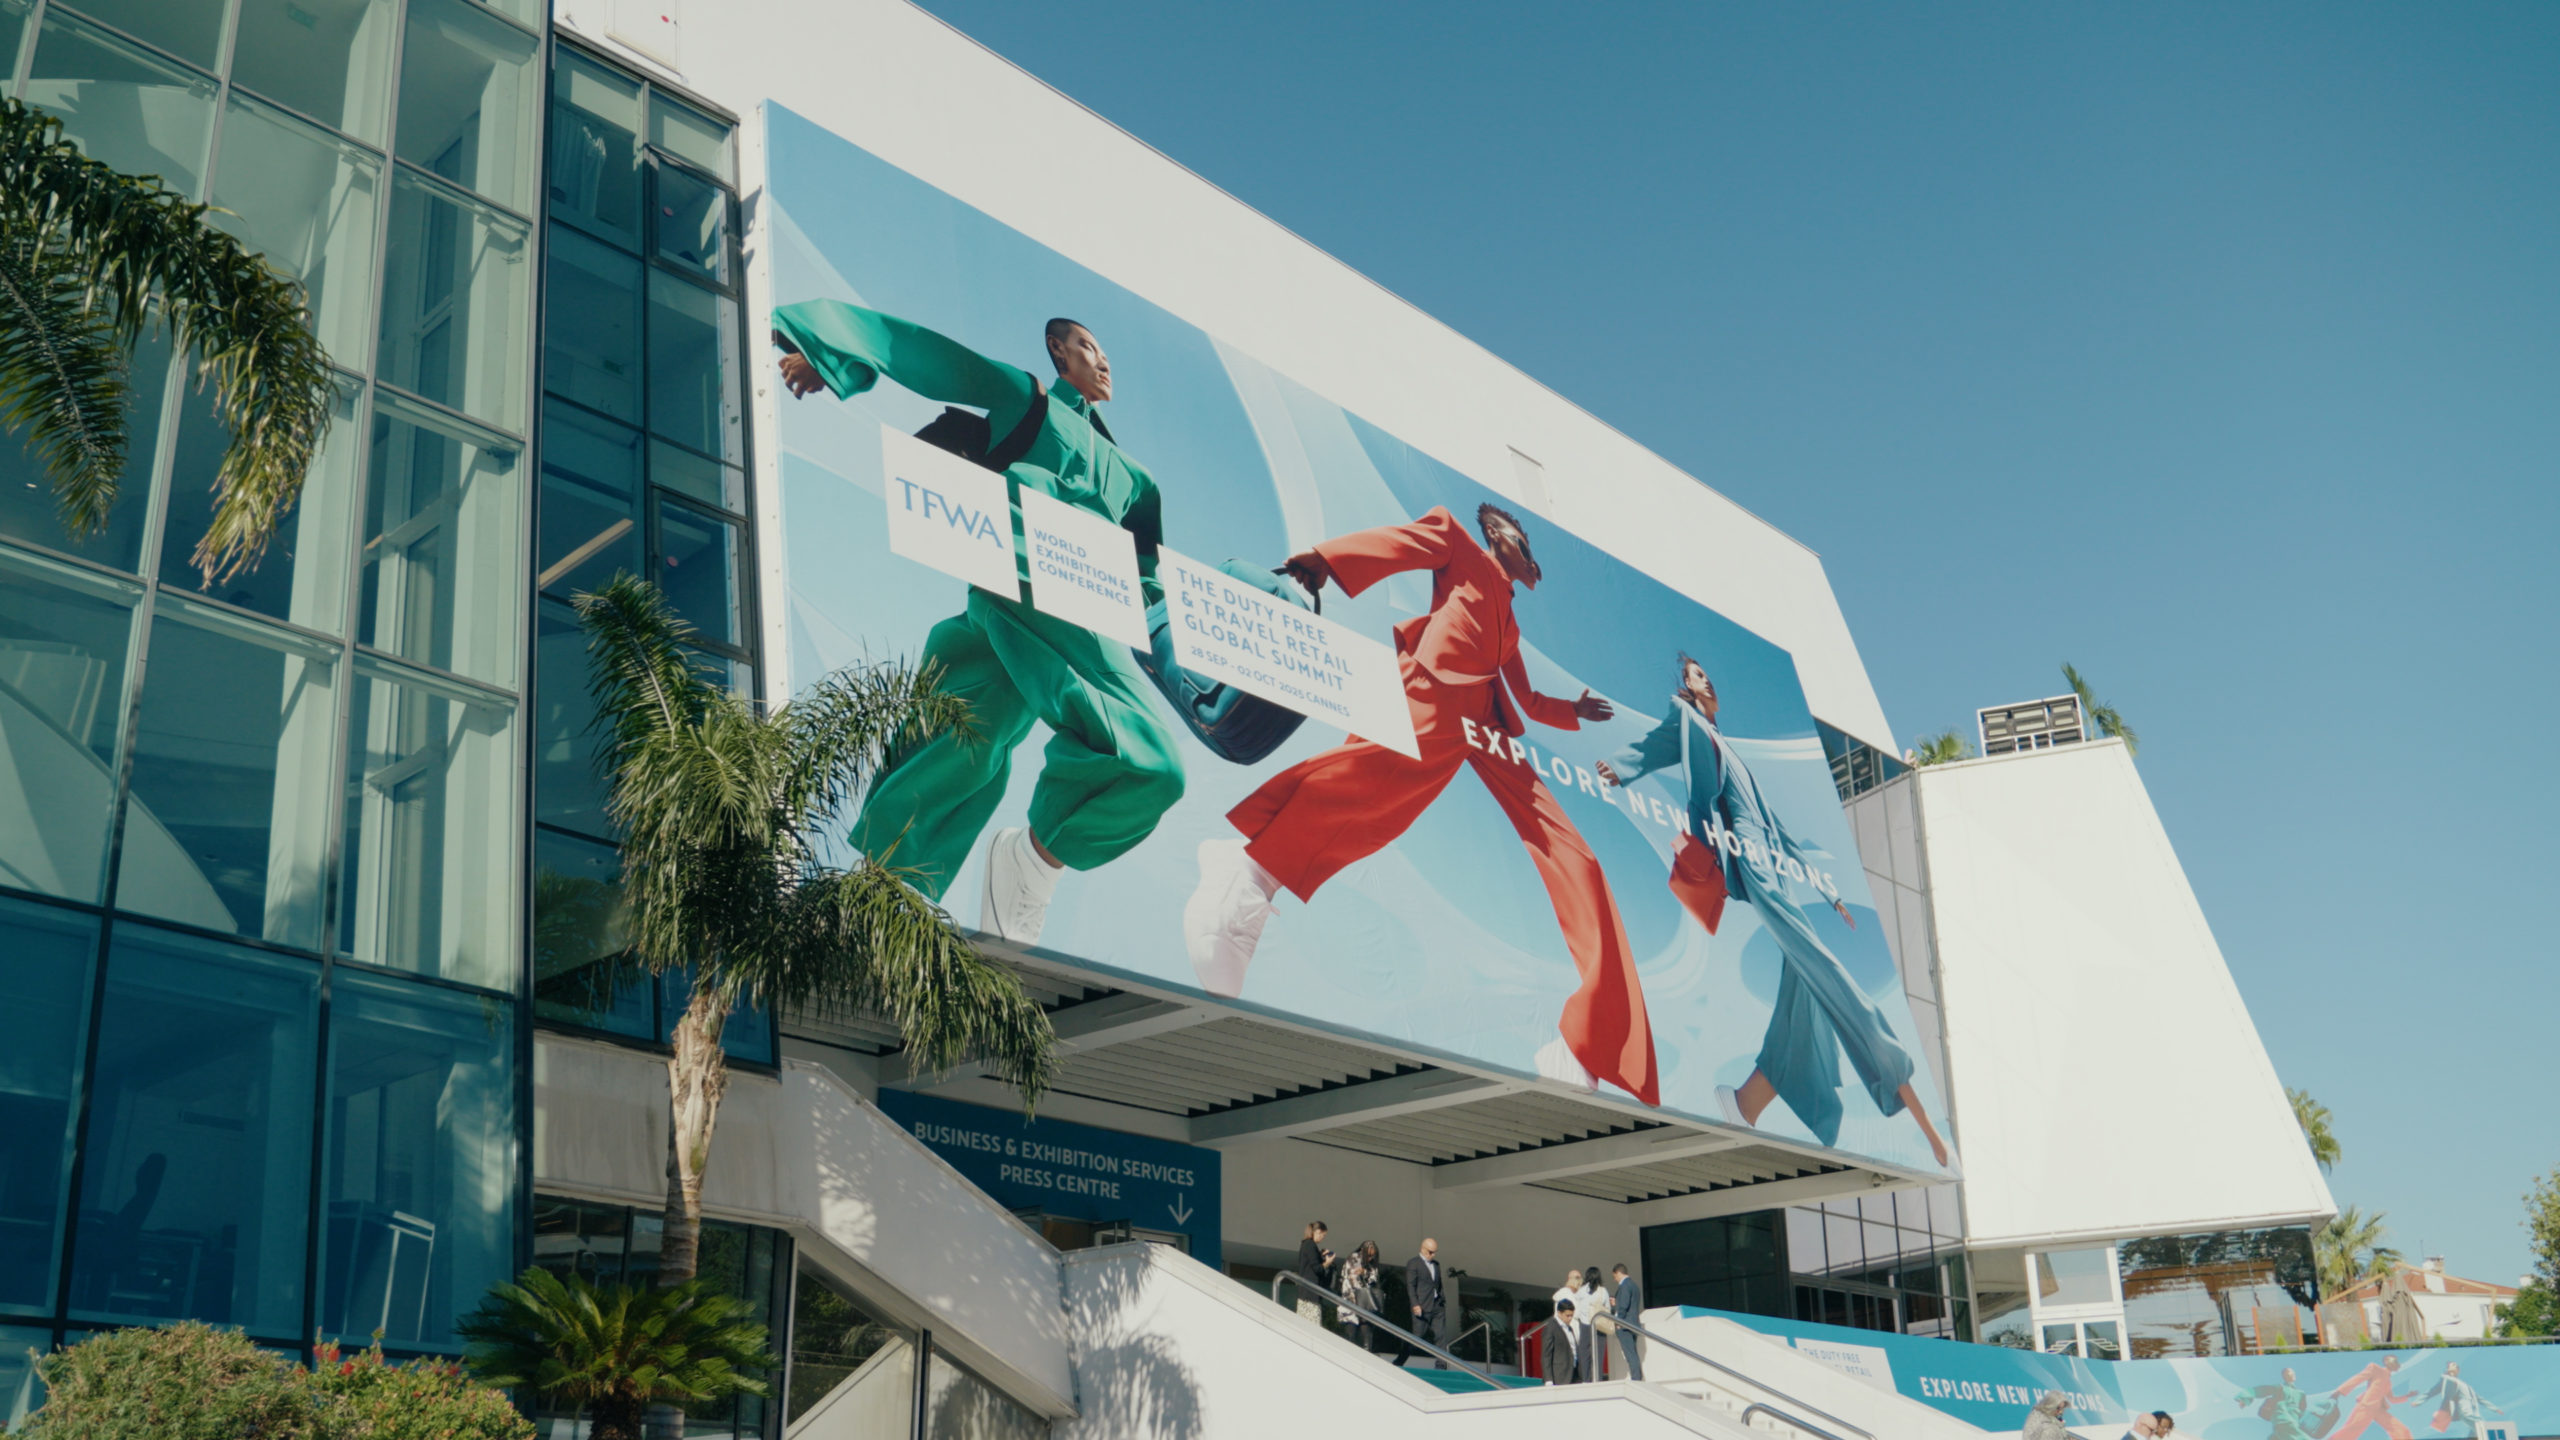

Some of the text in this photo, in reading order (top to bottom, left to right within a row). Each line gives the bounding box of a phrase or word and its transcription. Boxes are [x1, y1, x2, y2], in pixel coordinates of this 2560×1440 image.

[895, 476, 1004, 549] TFWA
[1033, 527, 1087, 558] WORLD
[1036, 544, 1129, 592] EXHIBITION &
[1037, 559, 1132, 607] CONFERENCE
[1176, 566, 1328, 646] THE DUTY FREE
[1181, 590, 1353, 676] & TRAVEL RETAIL
[1184, 613, 1344, 691] GLOBAL SUMMIT
[1190, 645, 1205, 659] 28
[1206, 650, 1229, 667] SEP
[1237, 664, 1252, 679] 02
[1254, 671, 1277, 688] OCT
[1279, 680, 1306, 700] 2025
[1306, 690, 1351, 718] CANNES
[1460, 716, 1839, 898] EXPLORE NEW HORIZONS
[914, 1121, 1195, 1187] BUSINESS & EXHIBITION SERVICES
[1000, 1163, 1121, 1201] PRESS CENTRE
[1803, 1347, 1861, 1364] THE DUTY FREE
[1919, 1376, 1995, 1403] EXPLORE
[1996, 1384, 2030, 1406] NEW
